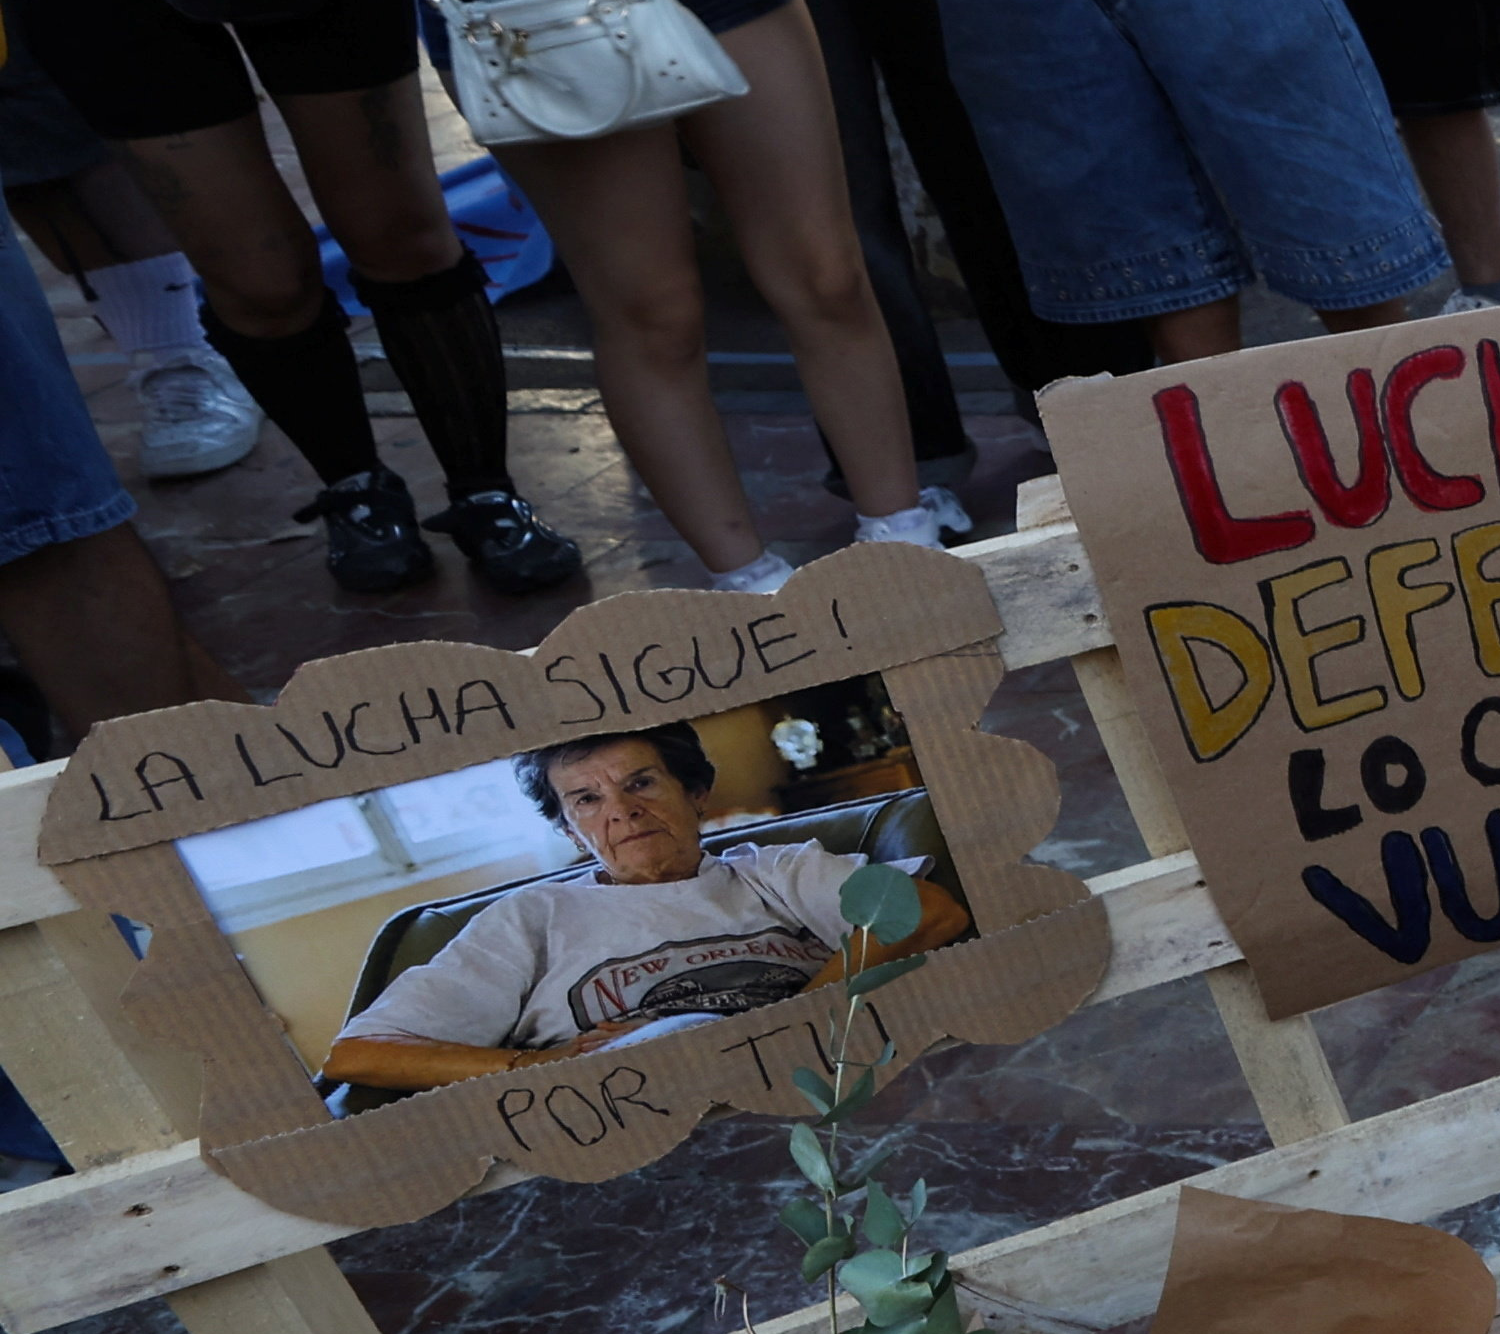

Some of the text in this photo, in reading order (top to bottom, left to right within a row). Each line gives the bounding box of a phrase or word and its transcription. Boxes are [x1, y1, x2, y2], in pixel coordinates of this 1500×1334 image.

[88, 750, 205, 825] LA
[233, 678, 518, 791] LUCHA
[1287, 734, 1427, 841] LO
[593, 955, 670, 1020] NEW
[496, 1066, 671, 1156] POR
